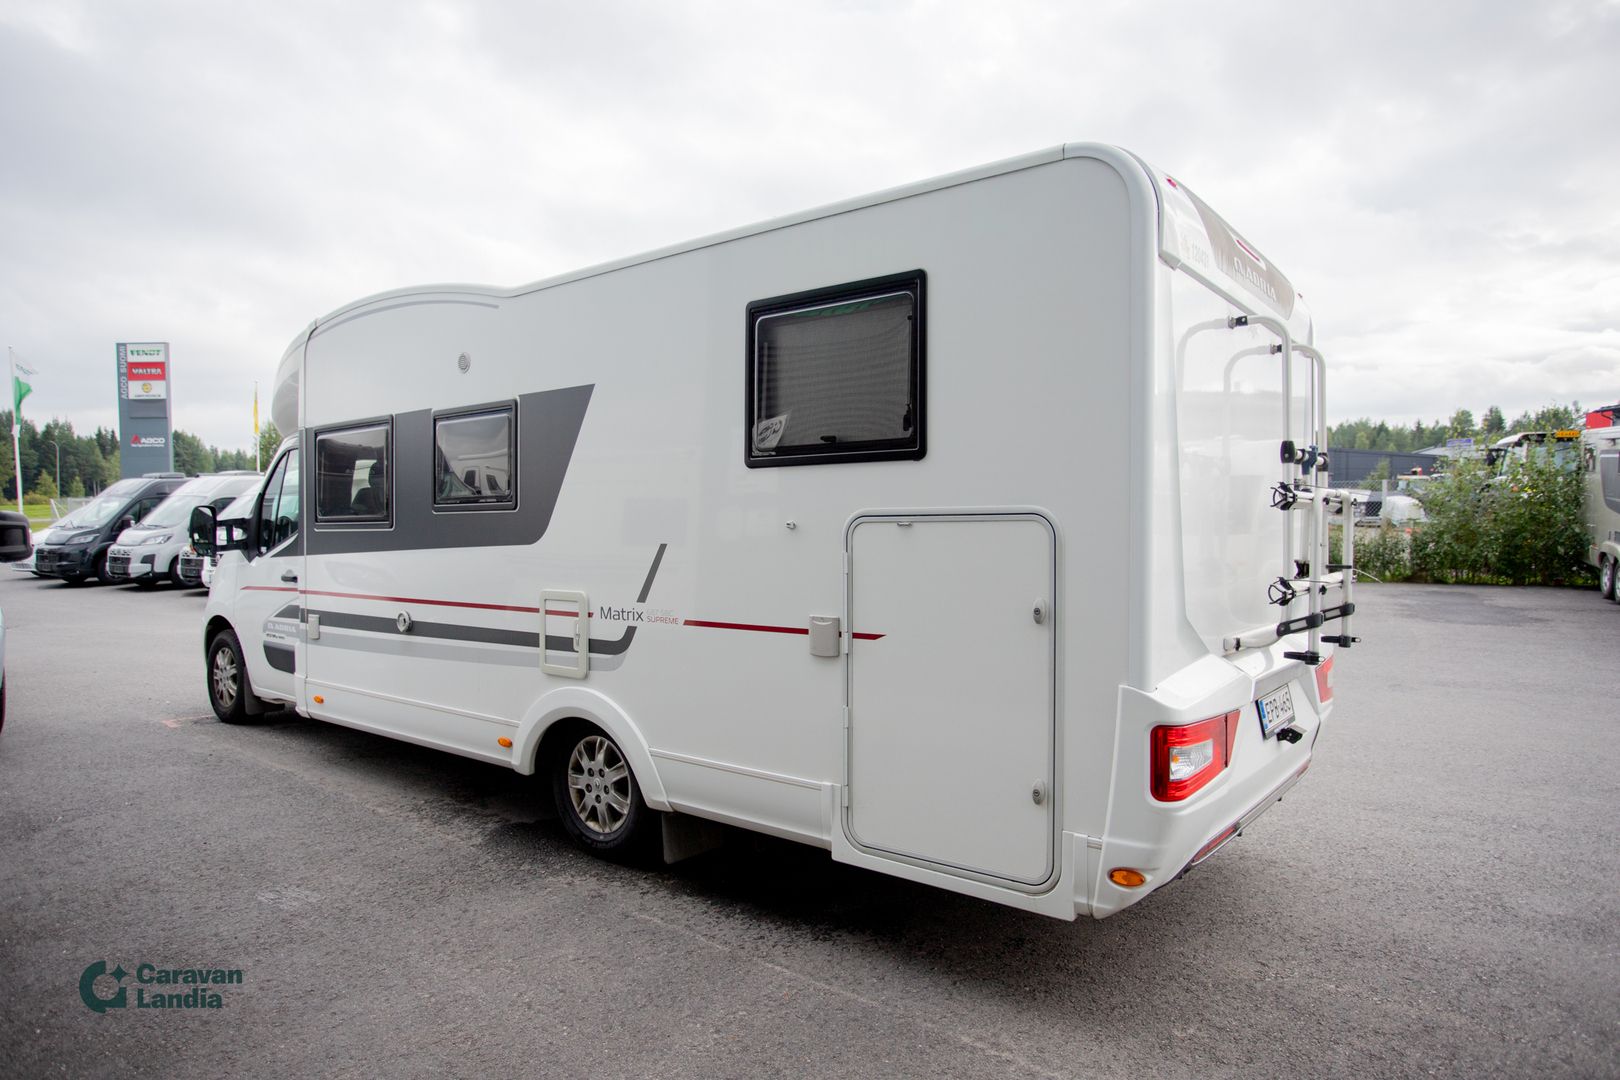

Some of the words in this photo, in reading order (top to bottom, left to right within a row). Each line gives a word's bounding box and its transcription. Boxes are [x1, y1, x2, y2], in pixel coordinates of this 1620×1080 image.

[131, 367, 162, 375] VALTRA
[120, 376, 128, 400] AGCO
[600, 606, 644, 622] Matrix
[647, 615, 679, 625] SUPREME
